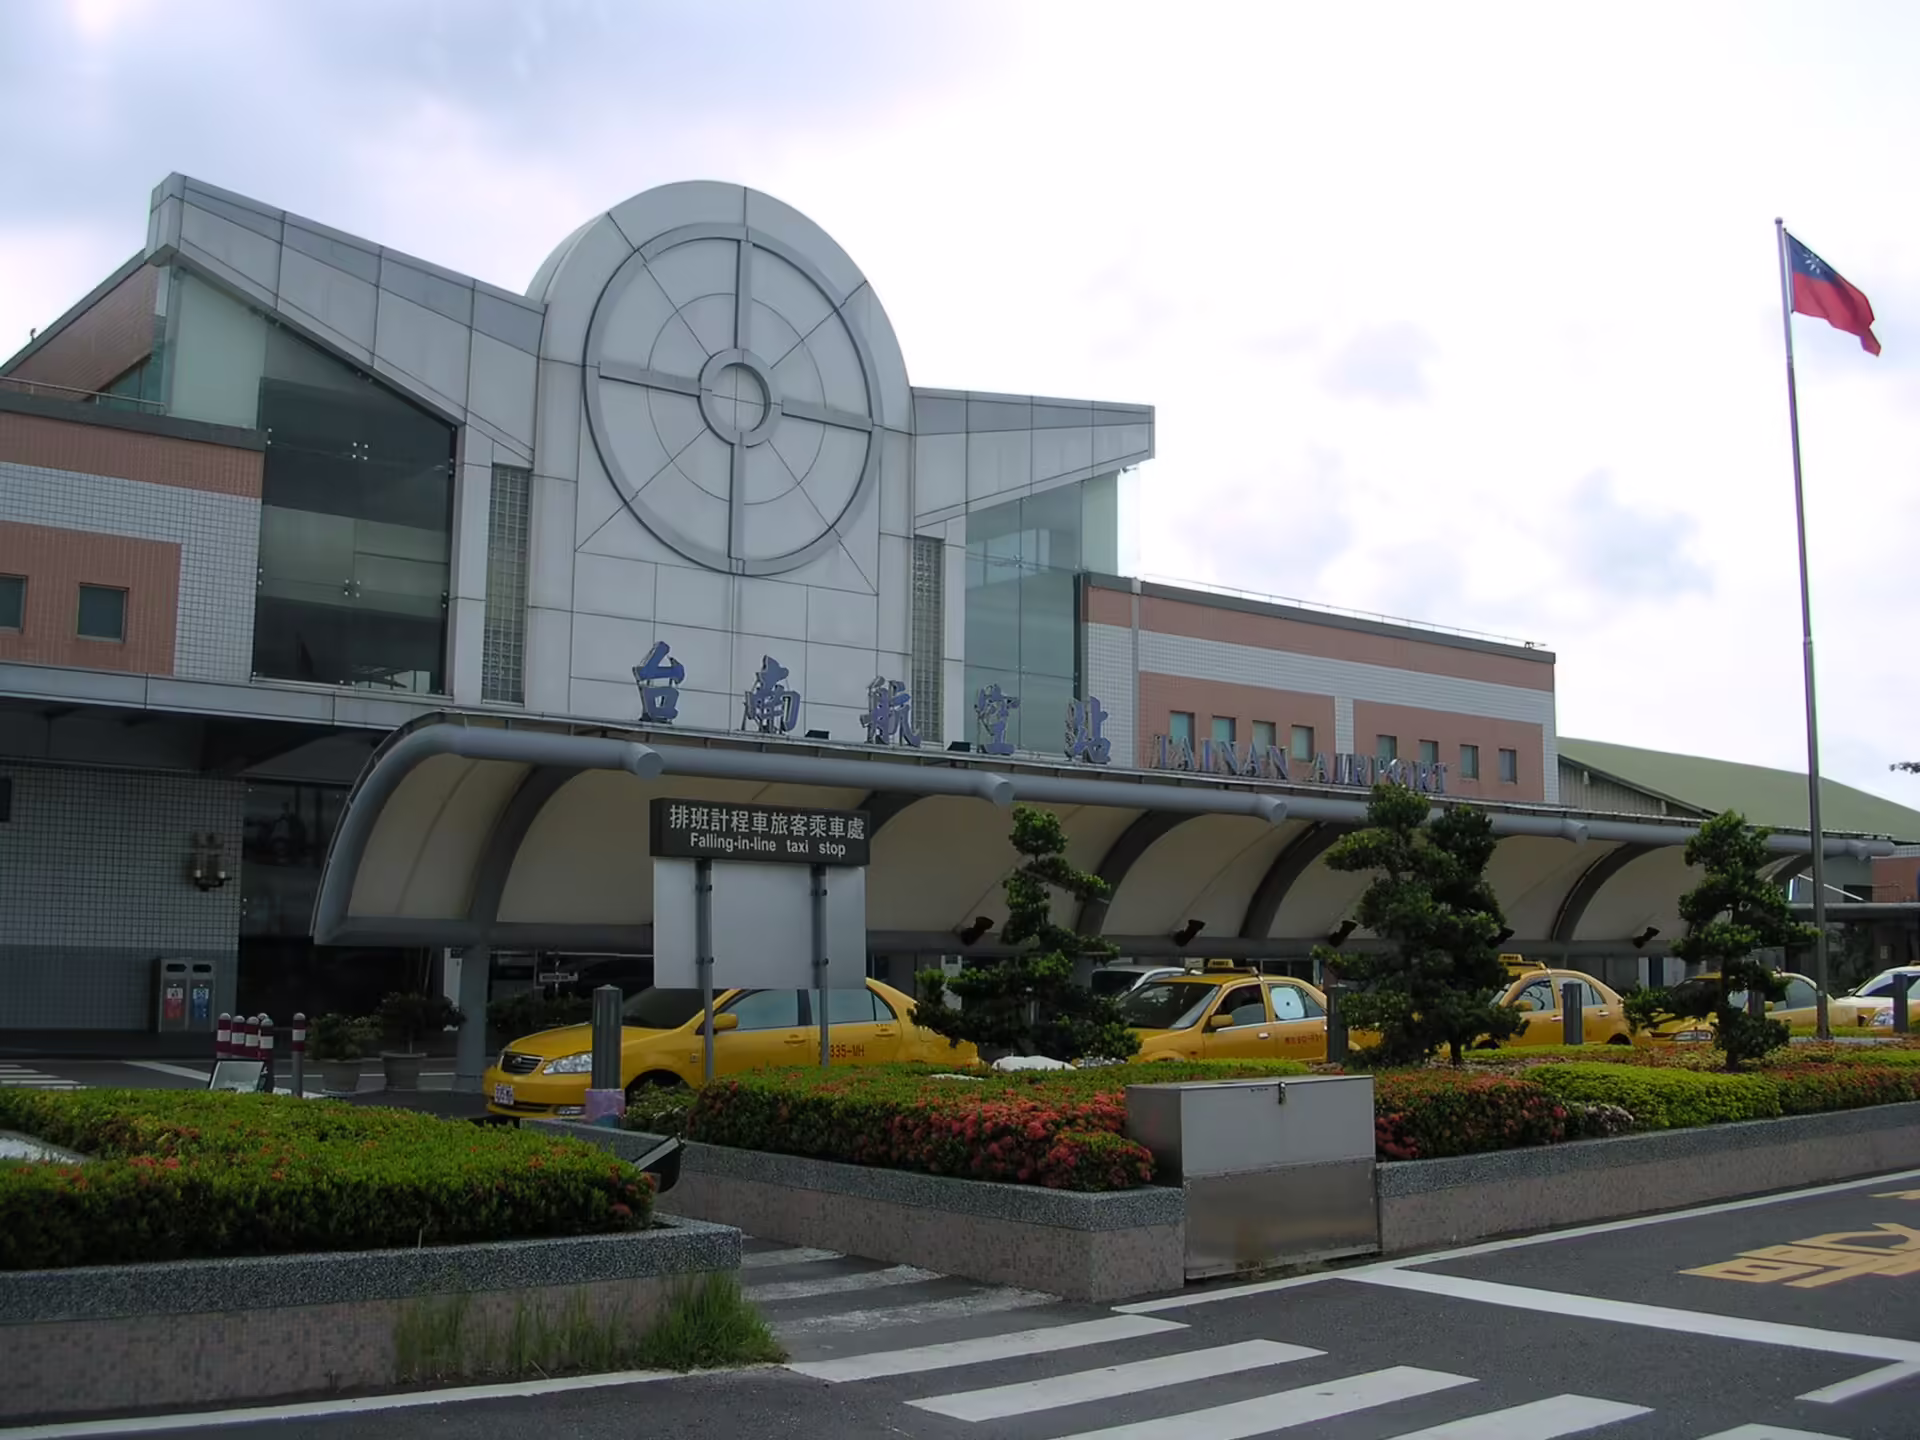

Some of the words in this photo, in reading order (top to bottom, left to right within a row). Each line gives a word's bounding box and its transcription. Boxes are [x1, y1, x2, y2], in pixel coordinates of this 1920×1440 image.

[1151, 734, 1288, 781] TAINAN
[1304, 752, 1448, 794] AIRPORT
[669, 805, 865, 840] 排班計程車旅客乘車處
[786, 839, 808, 853] taxi
[818, 842, 846, 858] stop
